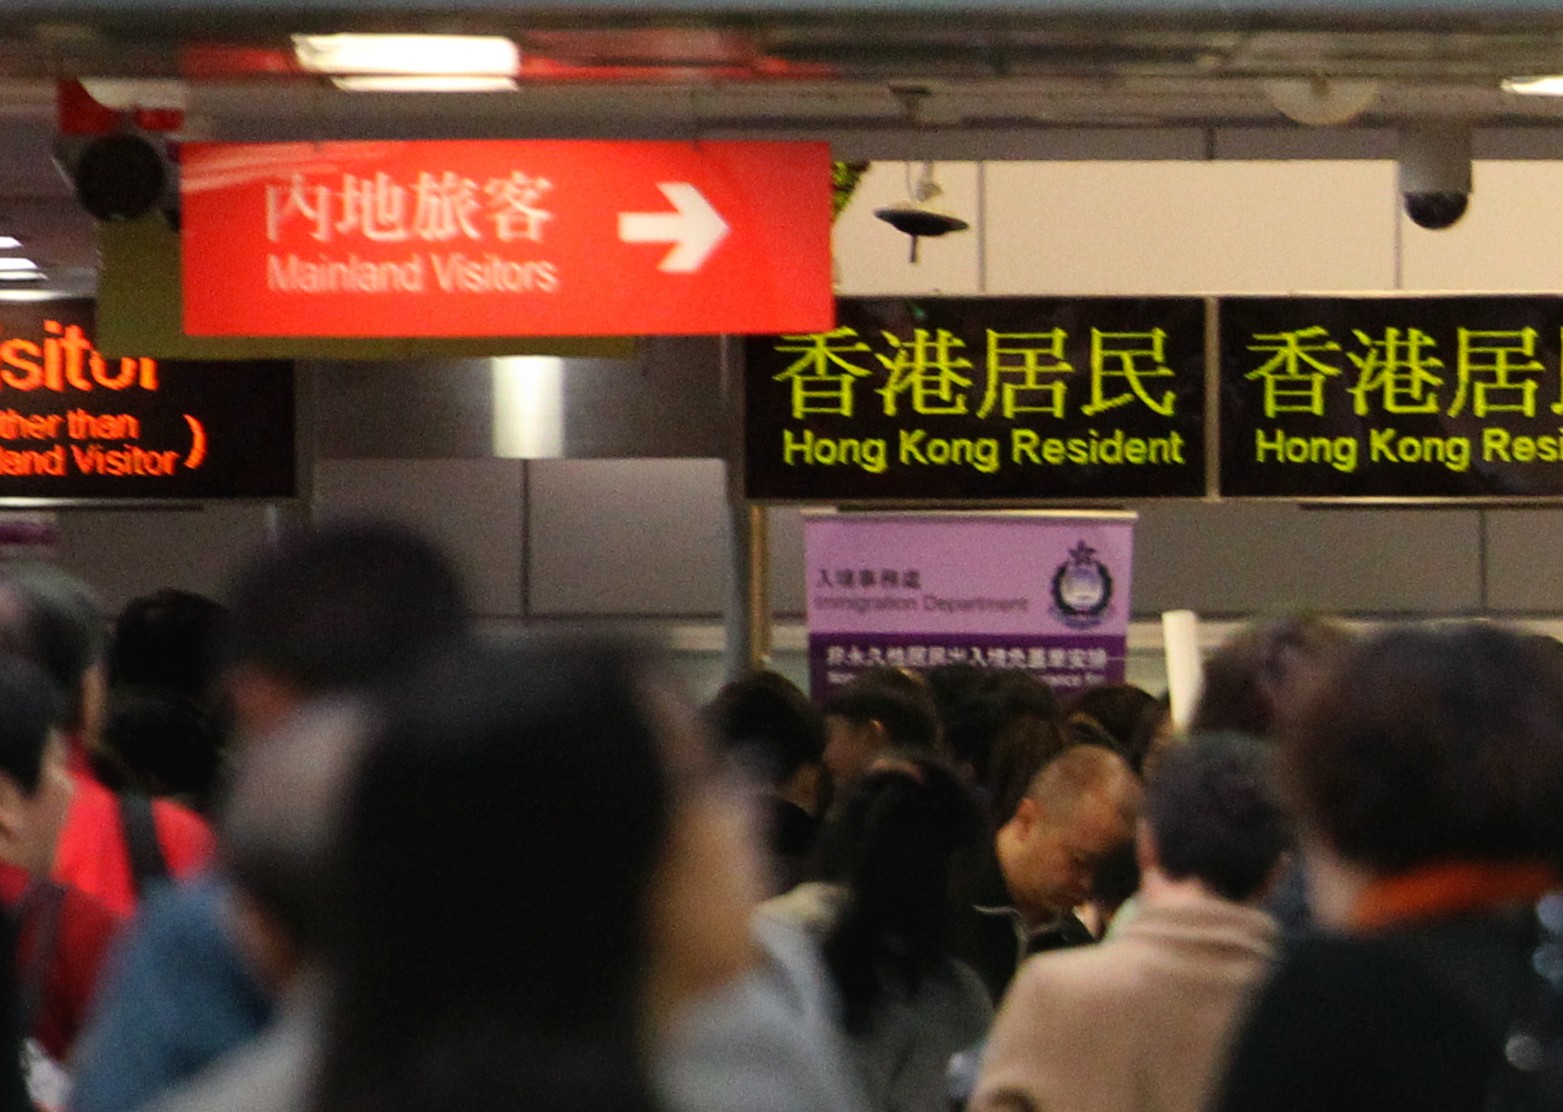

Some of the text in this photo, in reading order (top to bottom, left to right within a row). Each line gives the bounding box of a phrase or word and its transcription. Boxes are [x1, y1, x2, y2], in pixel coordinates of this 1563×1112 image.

[267, 252, 559, 293] Mainland Visitors
[774, 326, 1177, 419] 香港居民
[66, 407, 140, 440] than
[70, 443, 180, 476] Visitor
[785, 430, 1184, 473] Hong Kong Resident
[1257, 431, 1358, 473] Hong
[1371, 430, 1471, 472] Kong
